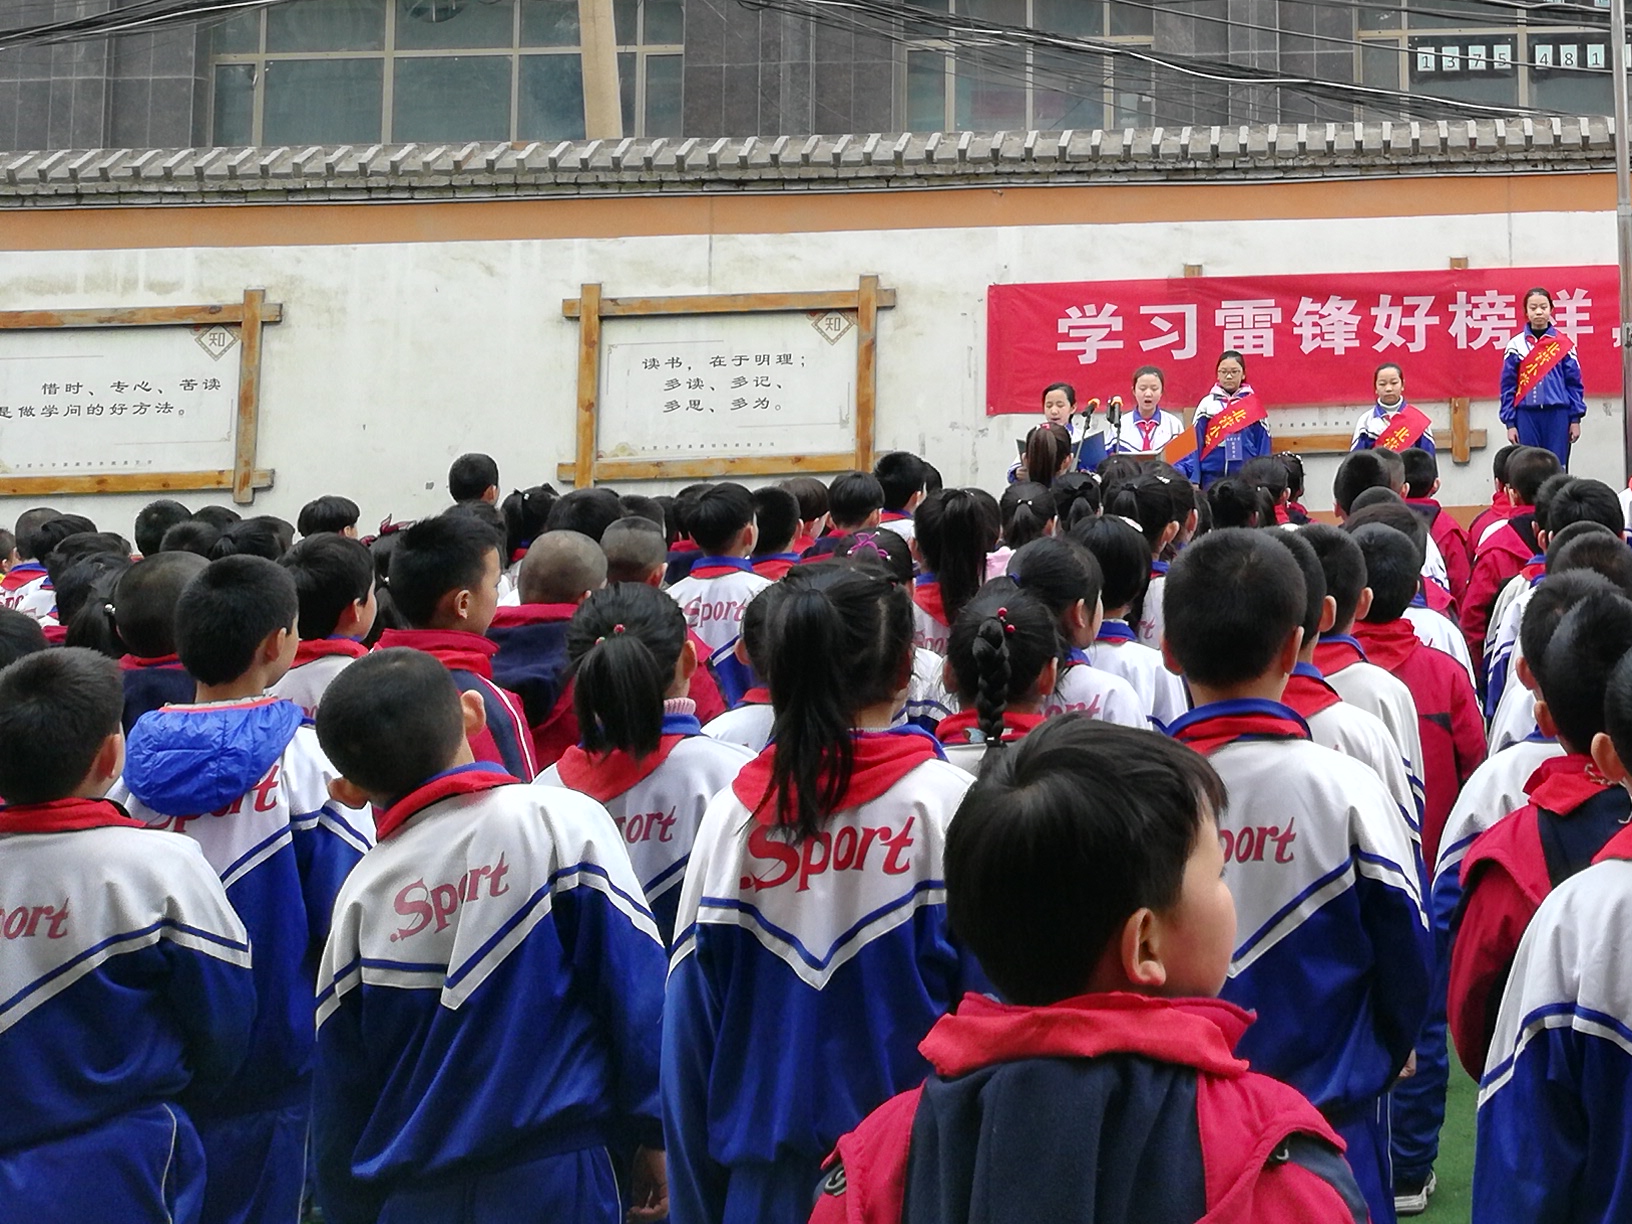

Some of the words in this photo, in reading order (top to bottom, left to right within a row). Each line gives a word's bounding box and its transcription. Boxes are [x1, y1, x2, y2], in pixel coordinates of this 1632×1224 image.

[824, 316, 841, 333] 知
[207, 331, 226, 348] 知
[41, 377, 222, 396] 惜时、专心、苦读
[739, 815, 916, 894] Sport
[389, 850, 511, 944] Sport
